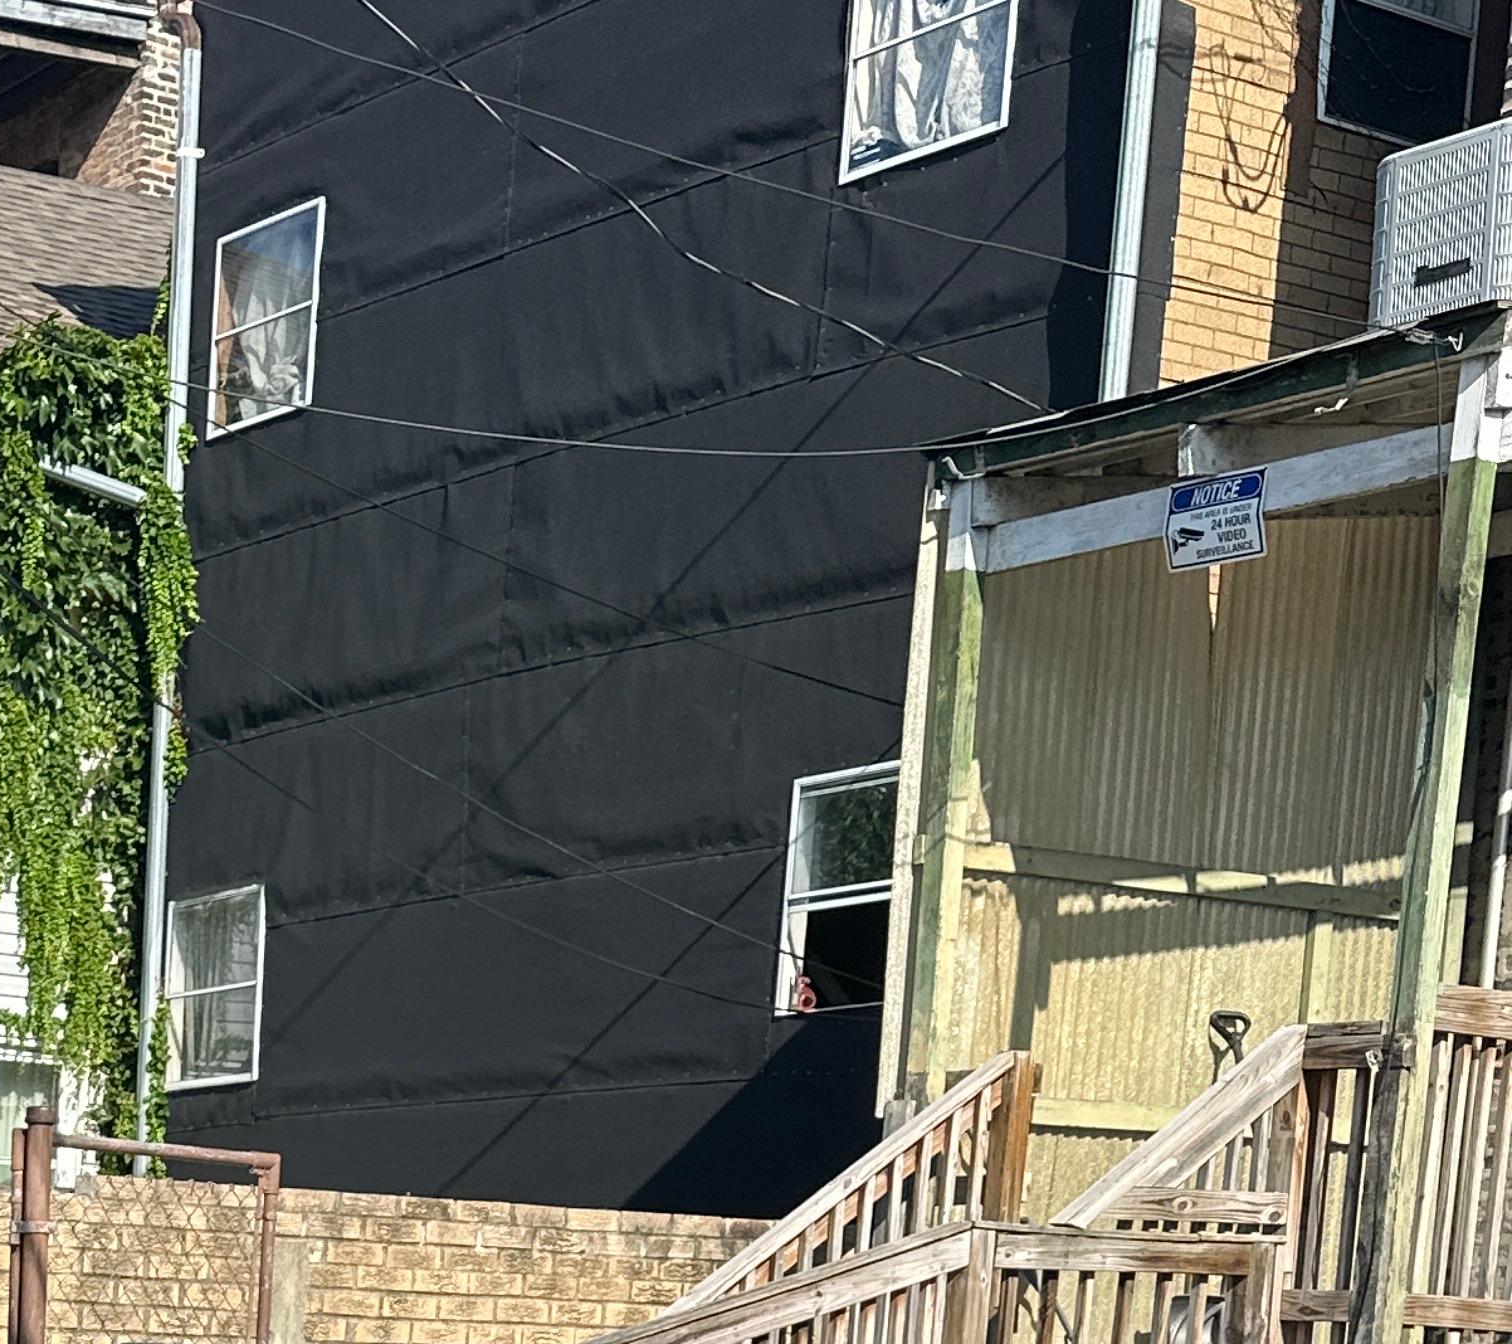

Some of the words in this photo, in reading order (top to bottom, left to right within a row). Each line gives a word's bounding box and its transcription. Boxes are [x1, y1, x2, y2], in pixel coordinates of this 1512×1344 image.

[1190, 477, 1243, 507] NOTICE
[1190, 511, 1203, 521] THIS
[1204, 508, 1221, 519] AREA
[1230, 502, 1253, 514] UNDER
[1210, 518, 1223, 531] 24
[1224, 513, 1252, 528] HOUR
[1217, 527, 1248, 543] VIDEO
[1196, 539, 1255, 560] SURVEILLANCE
